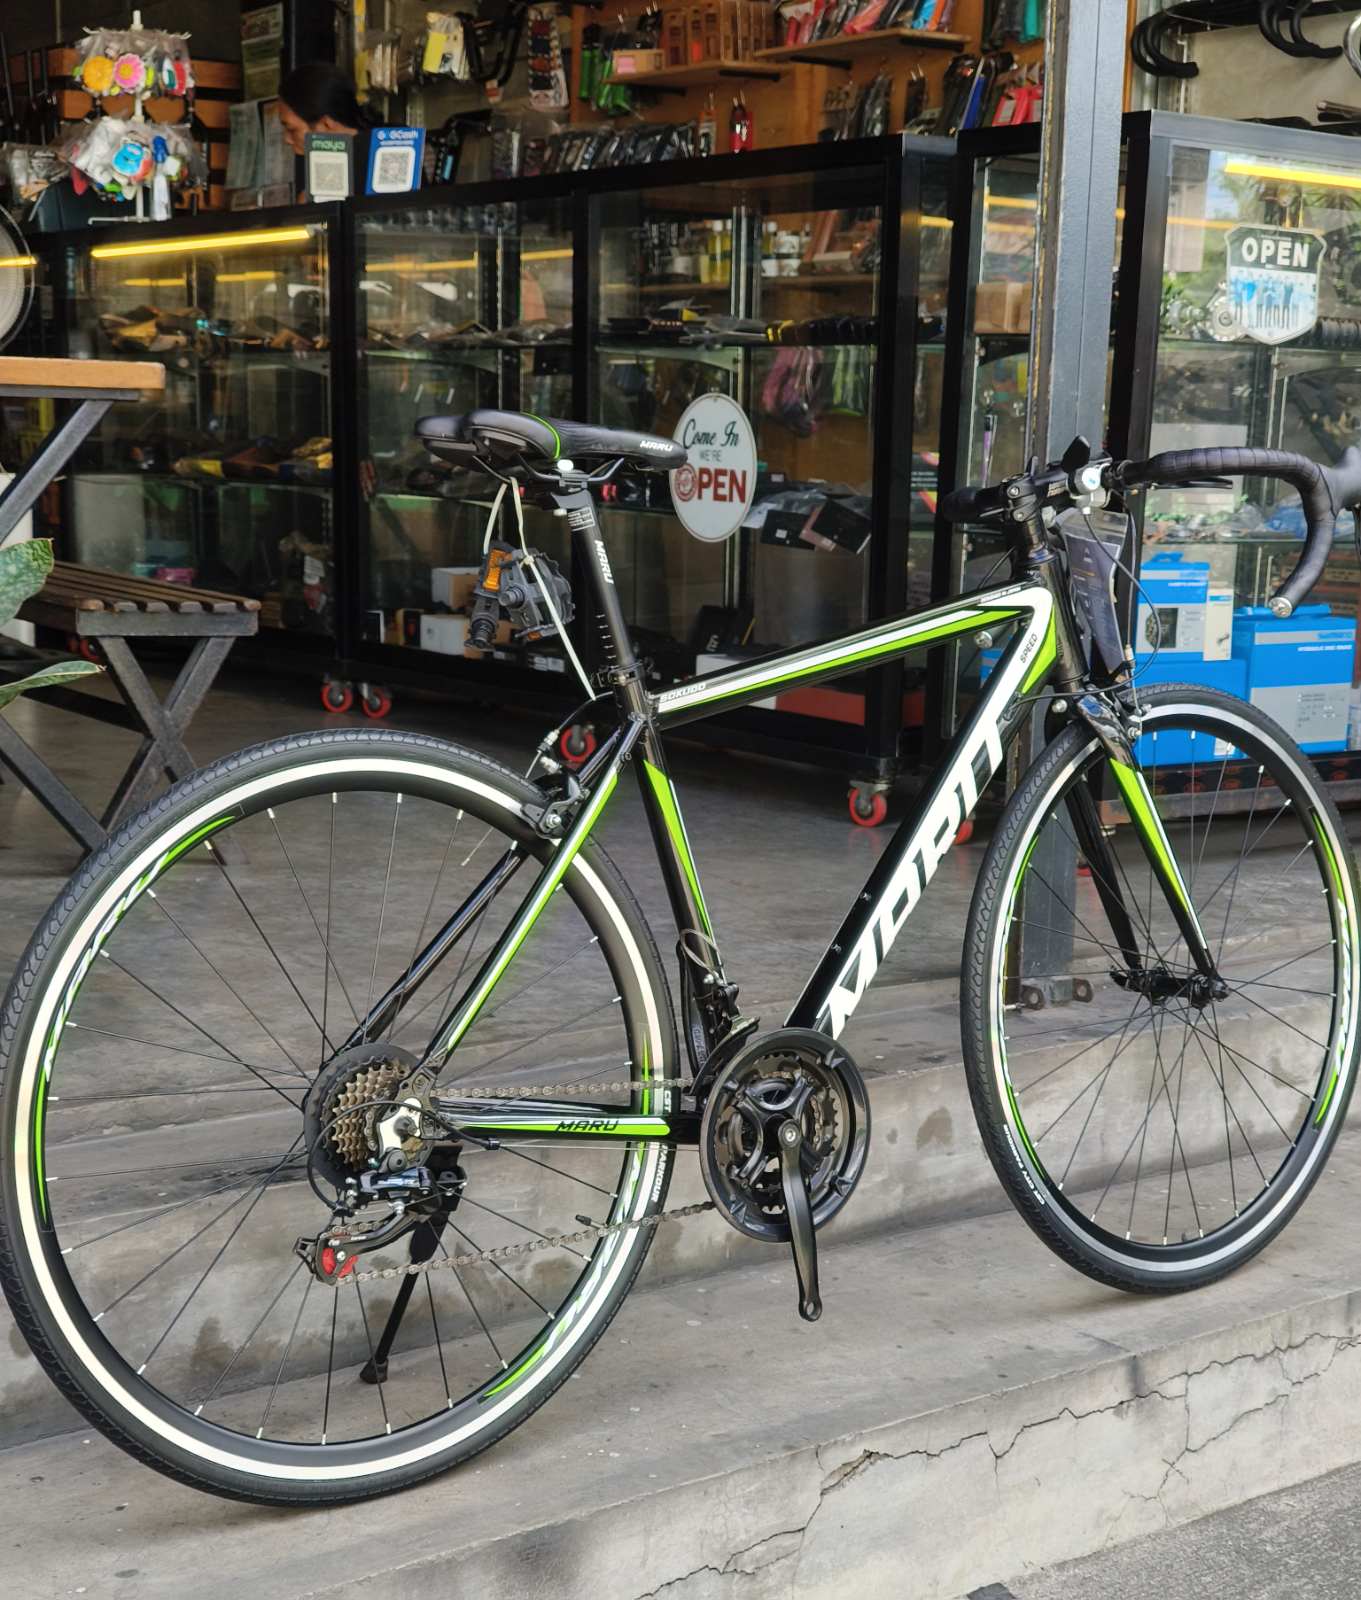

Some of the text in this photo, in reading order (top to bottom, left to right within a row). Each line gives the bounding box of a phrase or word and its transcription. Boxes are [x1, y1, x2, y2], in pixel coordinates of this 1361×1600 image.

[311, 140, 345, 152] maya
[1241, 236, 1310, 268] OPEN
[640, 440, 673, 452] MARU
[683, 418, 739, 449] Come In
[675, 463, 747, 504] OPEN
[595, 539, 615, 585] MARU
[1020, 633, 1038, 664] SPEED
[660, 683, 706, 702] SOKUDO
[664, 1090, 673, 1113] CST
[555, 1119, 619, 1132] MARU
[651, 1143, 669, 1203] PARKOUR
